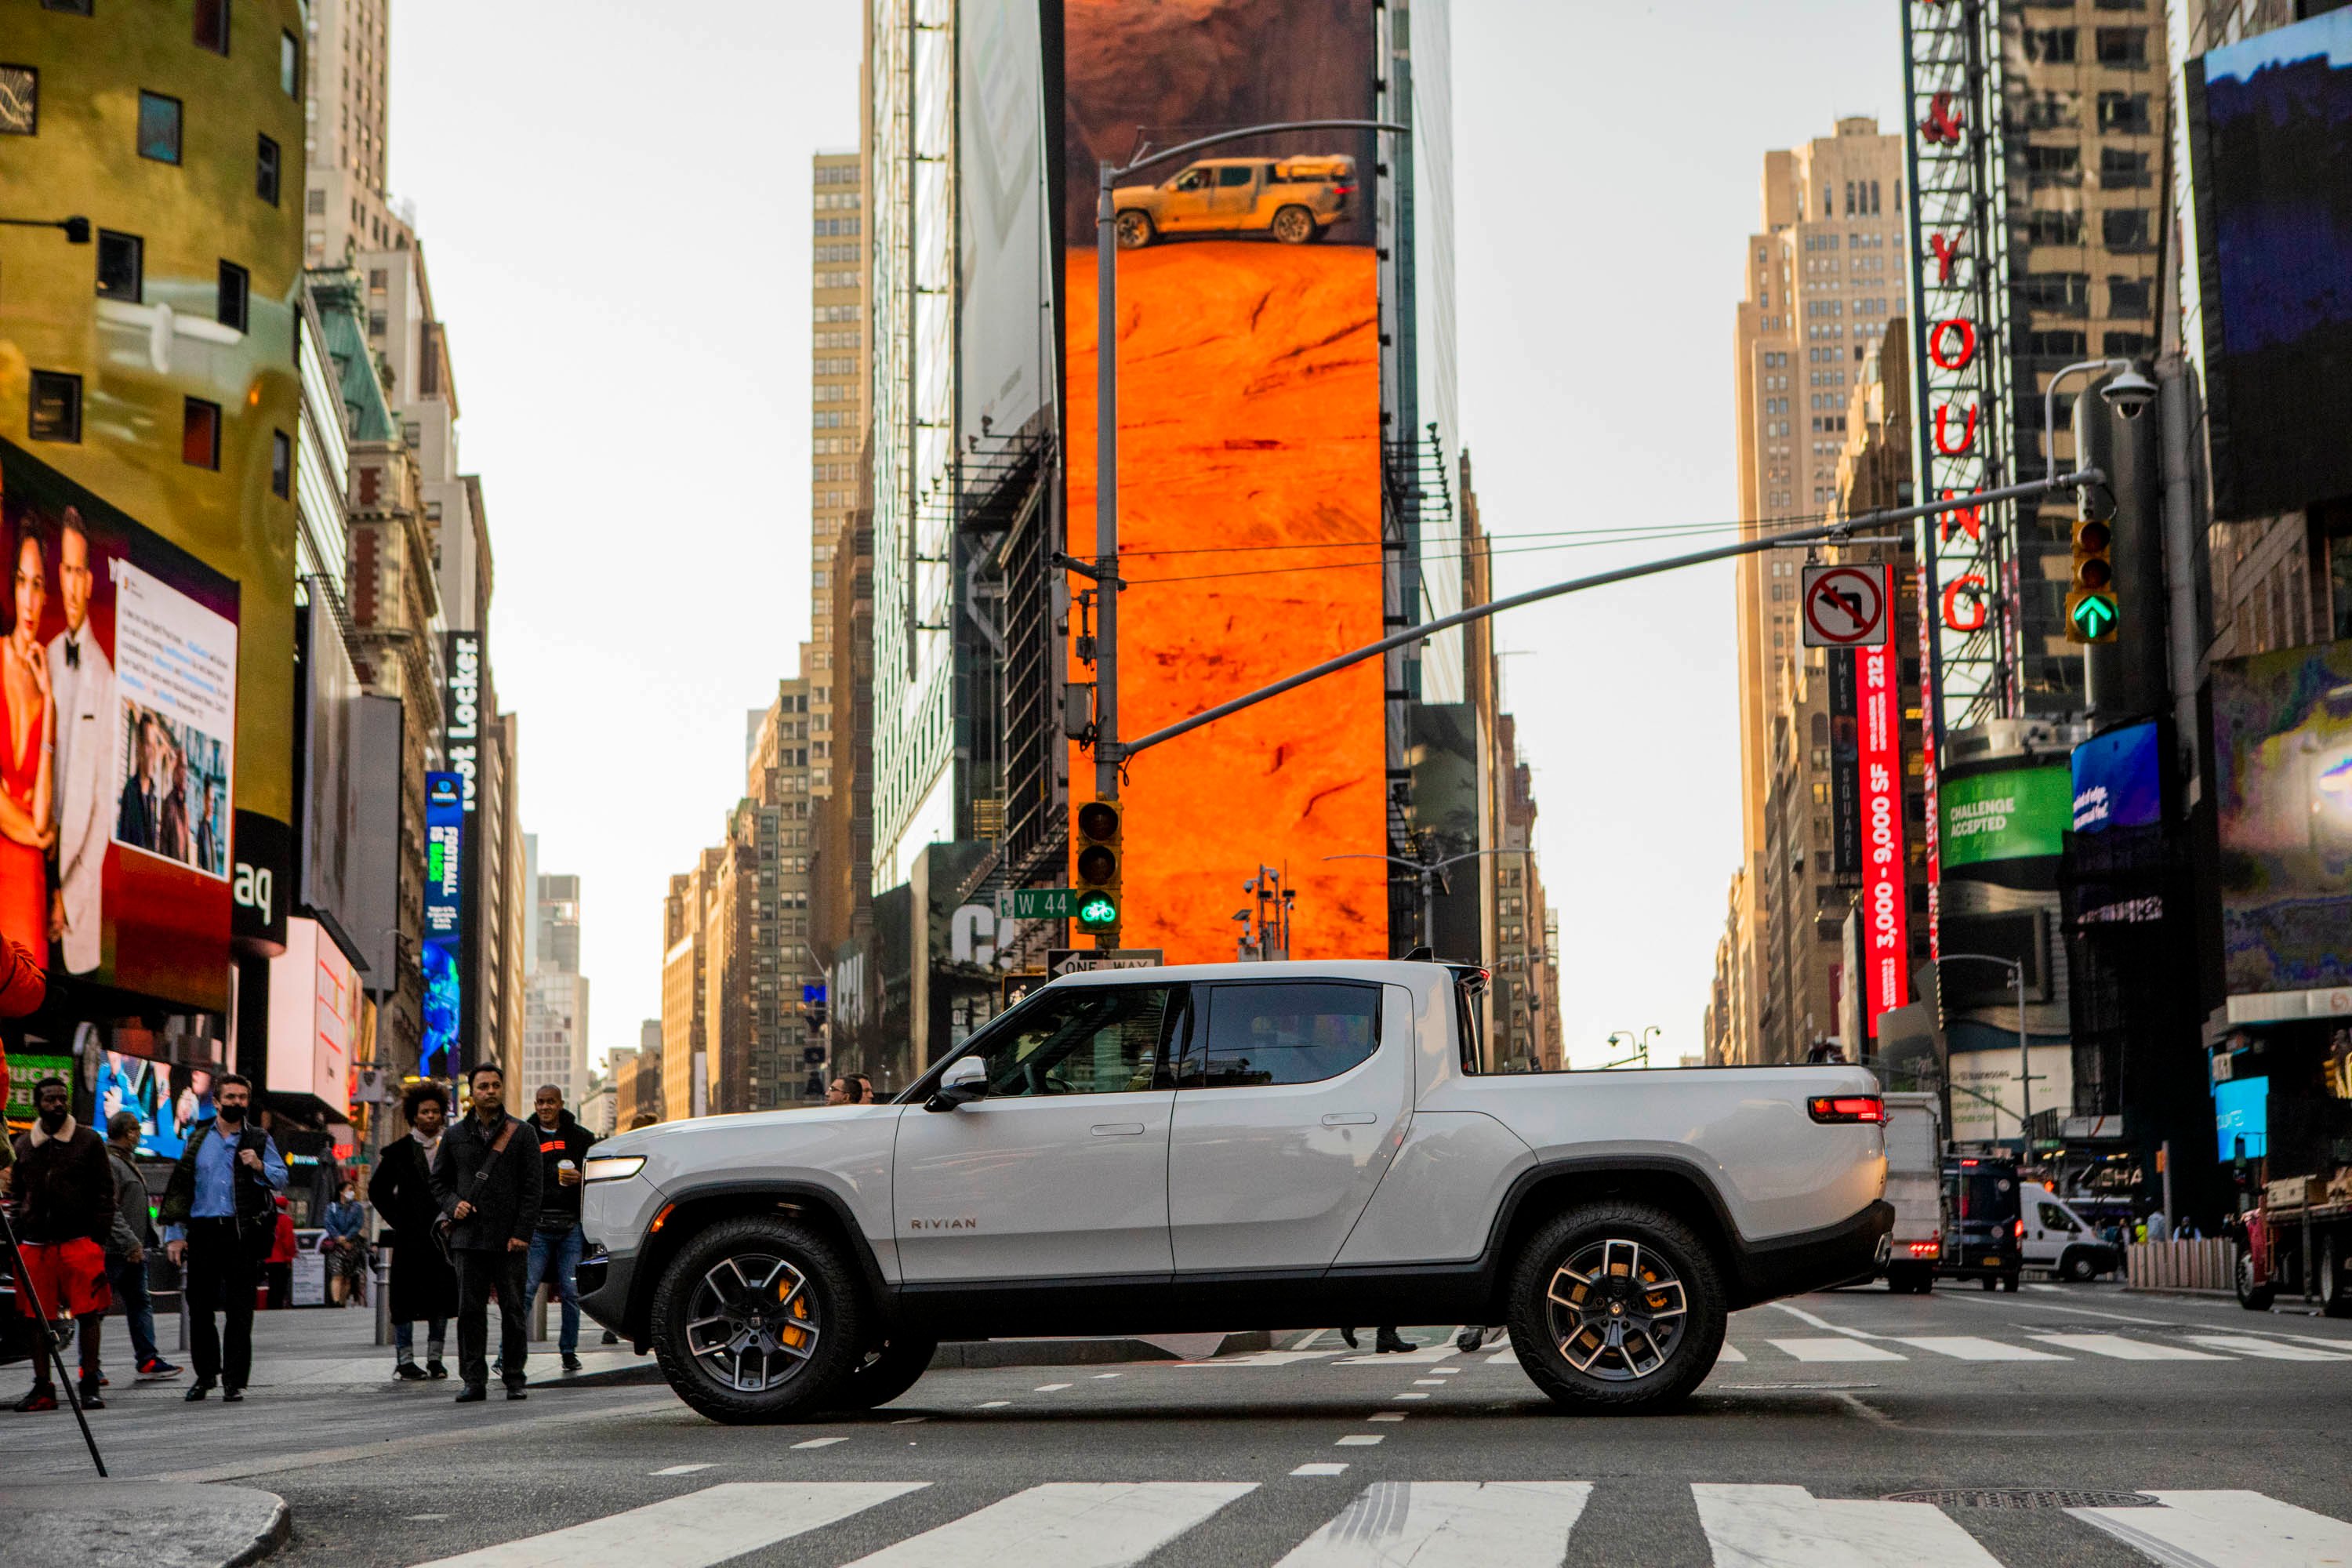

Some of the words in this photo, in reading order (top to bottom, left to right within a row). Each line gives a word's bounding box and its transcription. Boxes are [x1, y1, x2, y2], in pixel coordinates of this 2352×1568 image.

[1930, 230, 1986, 632] YOUNG
[1867, 655, 1885, 688] 212
[1871, 763, 1889, 793] SF
[1951, 797, 2015, 822] CHALLENGE
[1951, 815, 2007, 837] ACCEPTED
[1871, 796, 1894, 864] 9,000
[429, 843, 444, 882] BACK
[443, 826, 458, 897] FOOTBALL
[234, 862, 272, 925] aq
[1018, 893, 1035, 915] W
[1044, 893, 1067, 914] 44
[1875, 881, 1897, 949] 3,000
[1065, 961, 1098, 972] ONE
[911, 1218, 976, 1229] RIVIAN
